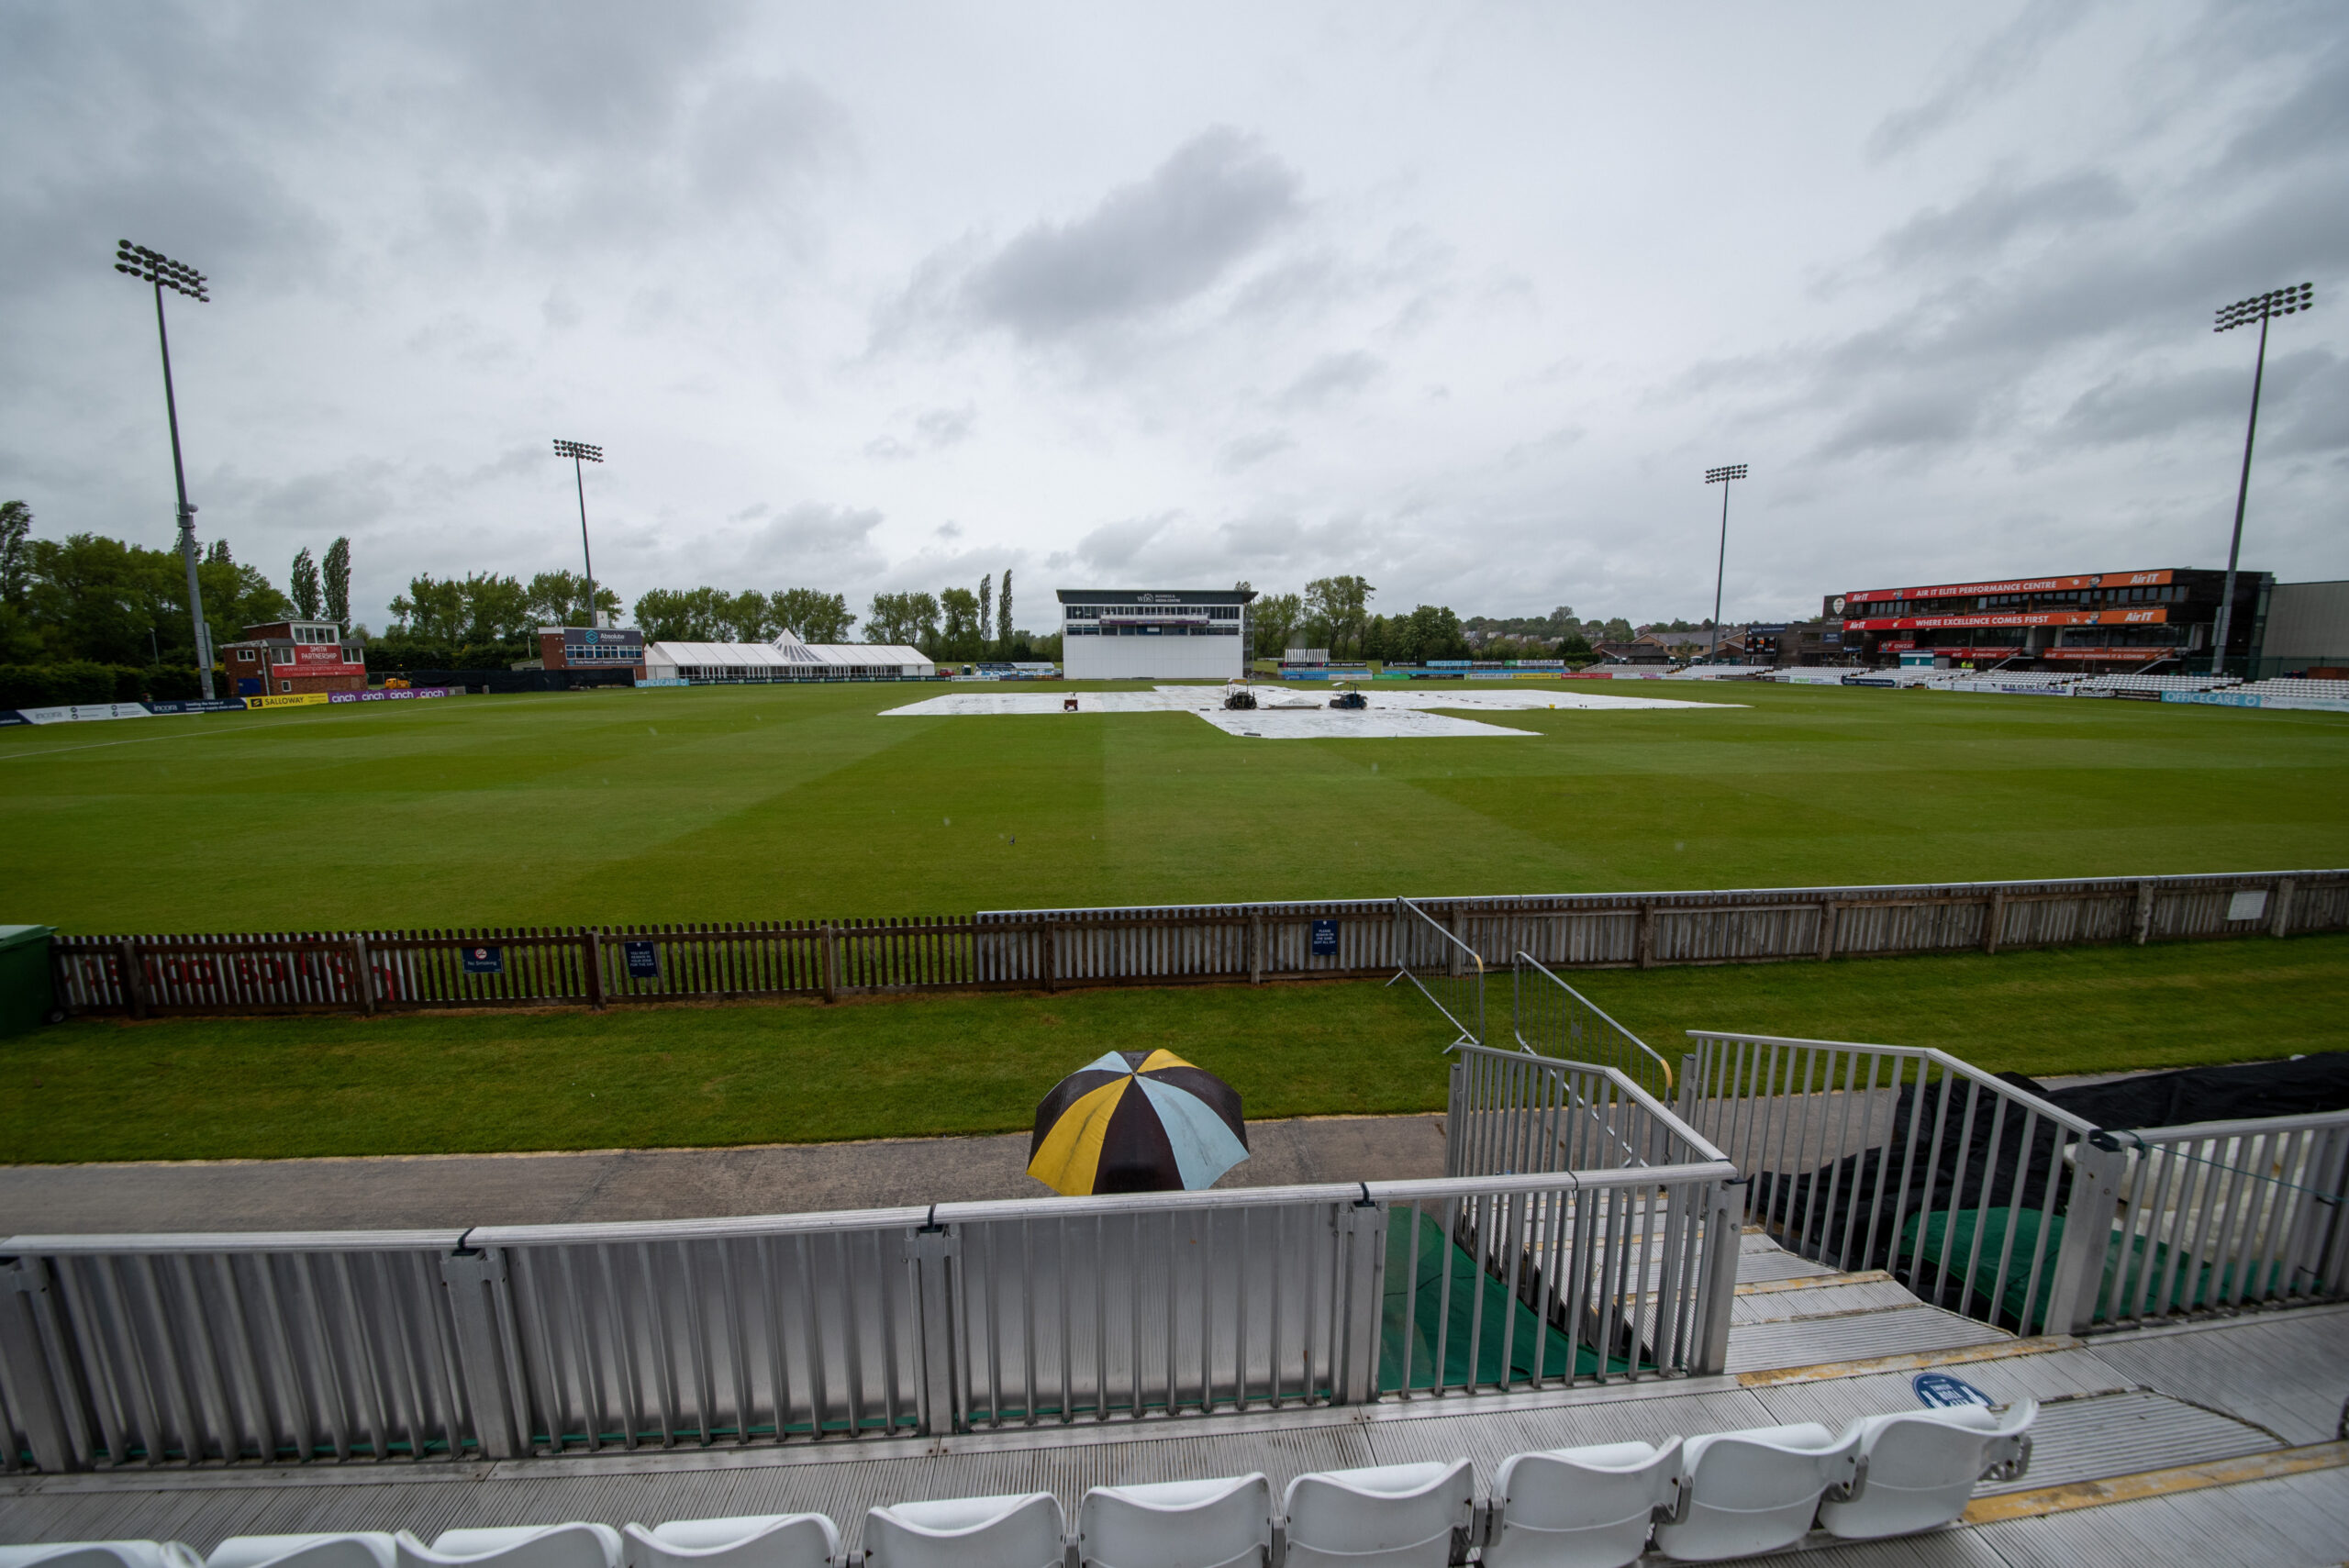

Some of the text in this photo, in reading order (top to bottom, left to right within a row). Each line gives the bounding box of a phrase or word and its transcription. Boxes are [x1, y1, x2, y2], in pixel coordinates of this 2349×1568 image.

[1939, 587, 1957, 595] ELITE
[1959, 584, 2021, 595] PERFORMANCE
[2023, 581, 2056, 590] CENTRE
[1943, 617, 1989, 626] EXCELLENCE
[1991, 617, 2021, 625] COMES
[2024, 616, 2049, 624] FIRST
[332, 693, 355, 703] cinch
[362, 691, 384, 701] cinch
[390, 690, 414, 700] cinch
[420, 688, 444, 698] cinch
[265, 696, 304, 706] SALLOWAY
[2166, 692, 2239, 705] OFFICECARE
